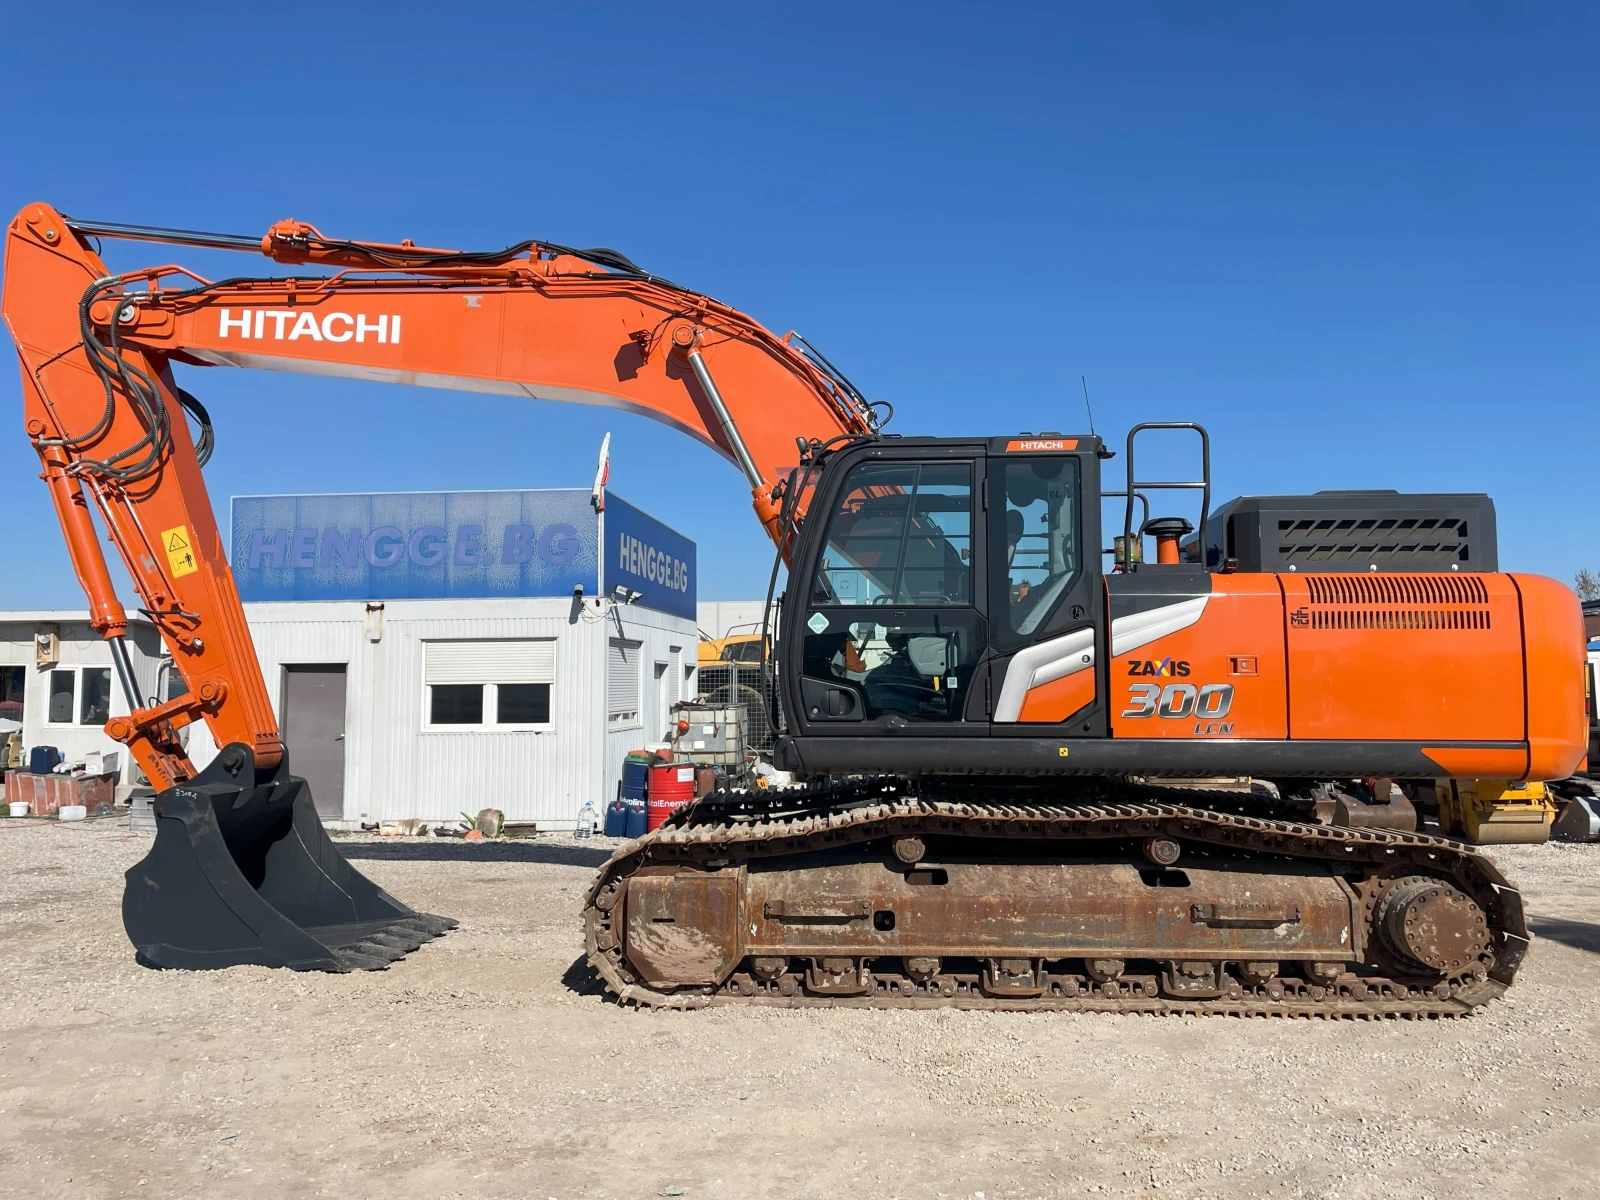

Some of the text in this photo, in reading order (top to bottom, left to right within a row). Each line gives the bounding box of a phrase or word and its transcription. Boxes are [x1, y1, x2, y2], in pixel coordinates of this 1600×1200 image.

[218, 308, 402, 345] HITACHI
[1020, 441, 1064, 450] HITACHI
[250, 524, 579, 568] HENGGE.BG
[620, 532, 687, 593] HENGGE.BG
[1127, 657, 1191, 677] ZAXIS
[1121, 683, 1235, 719] 300
[1193, 721, 1235, 735] LCN
